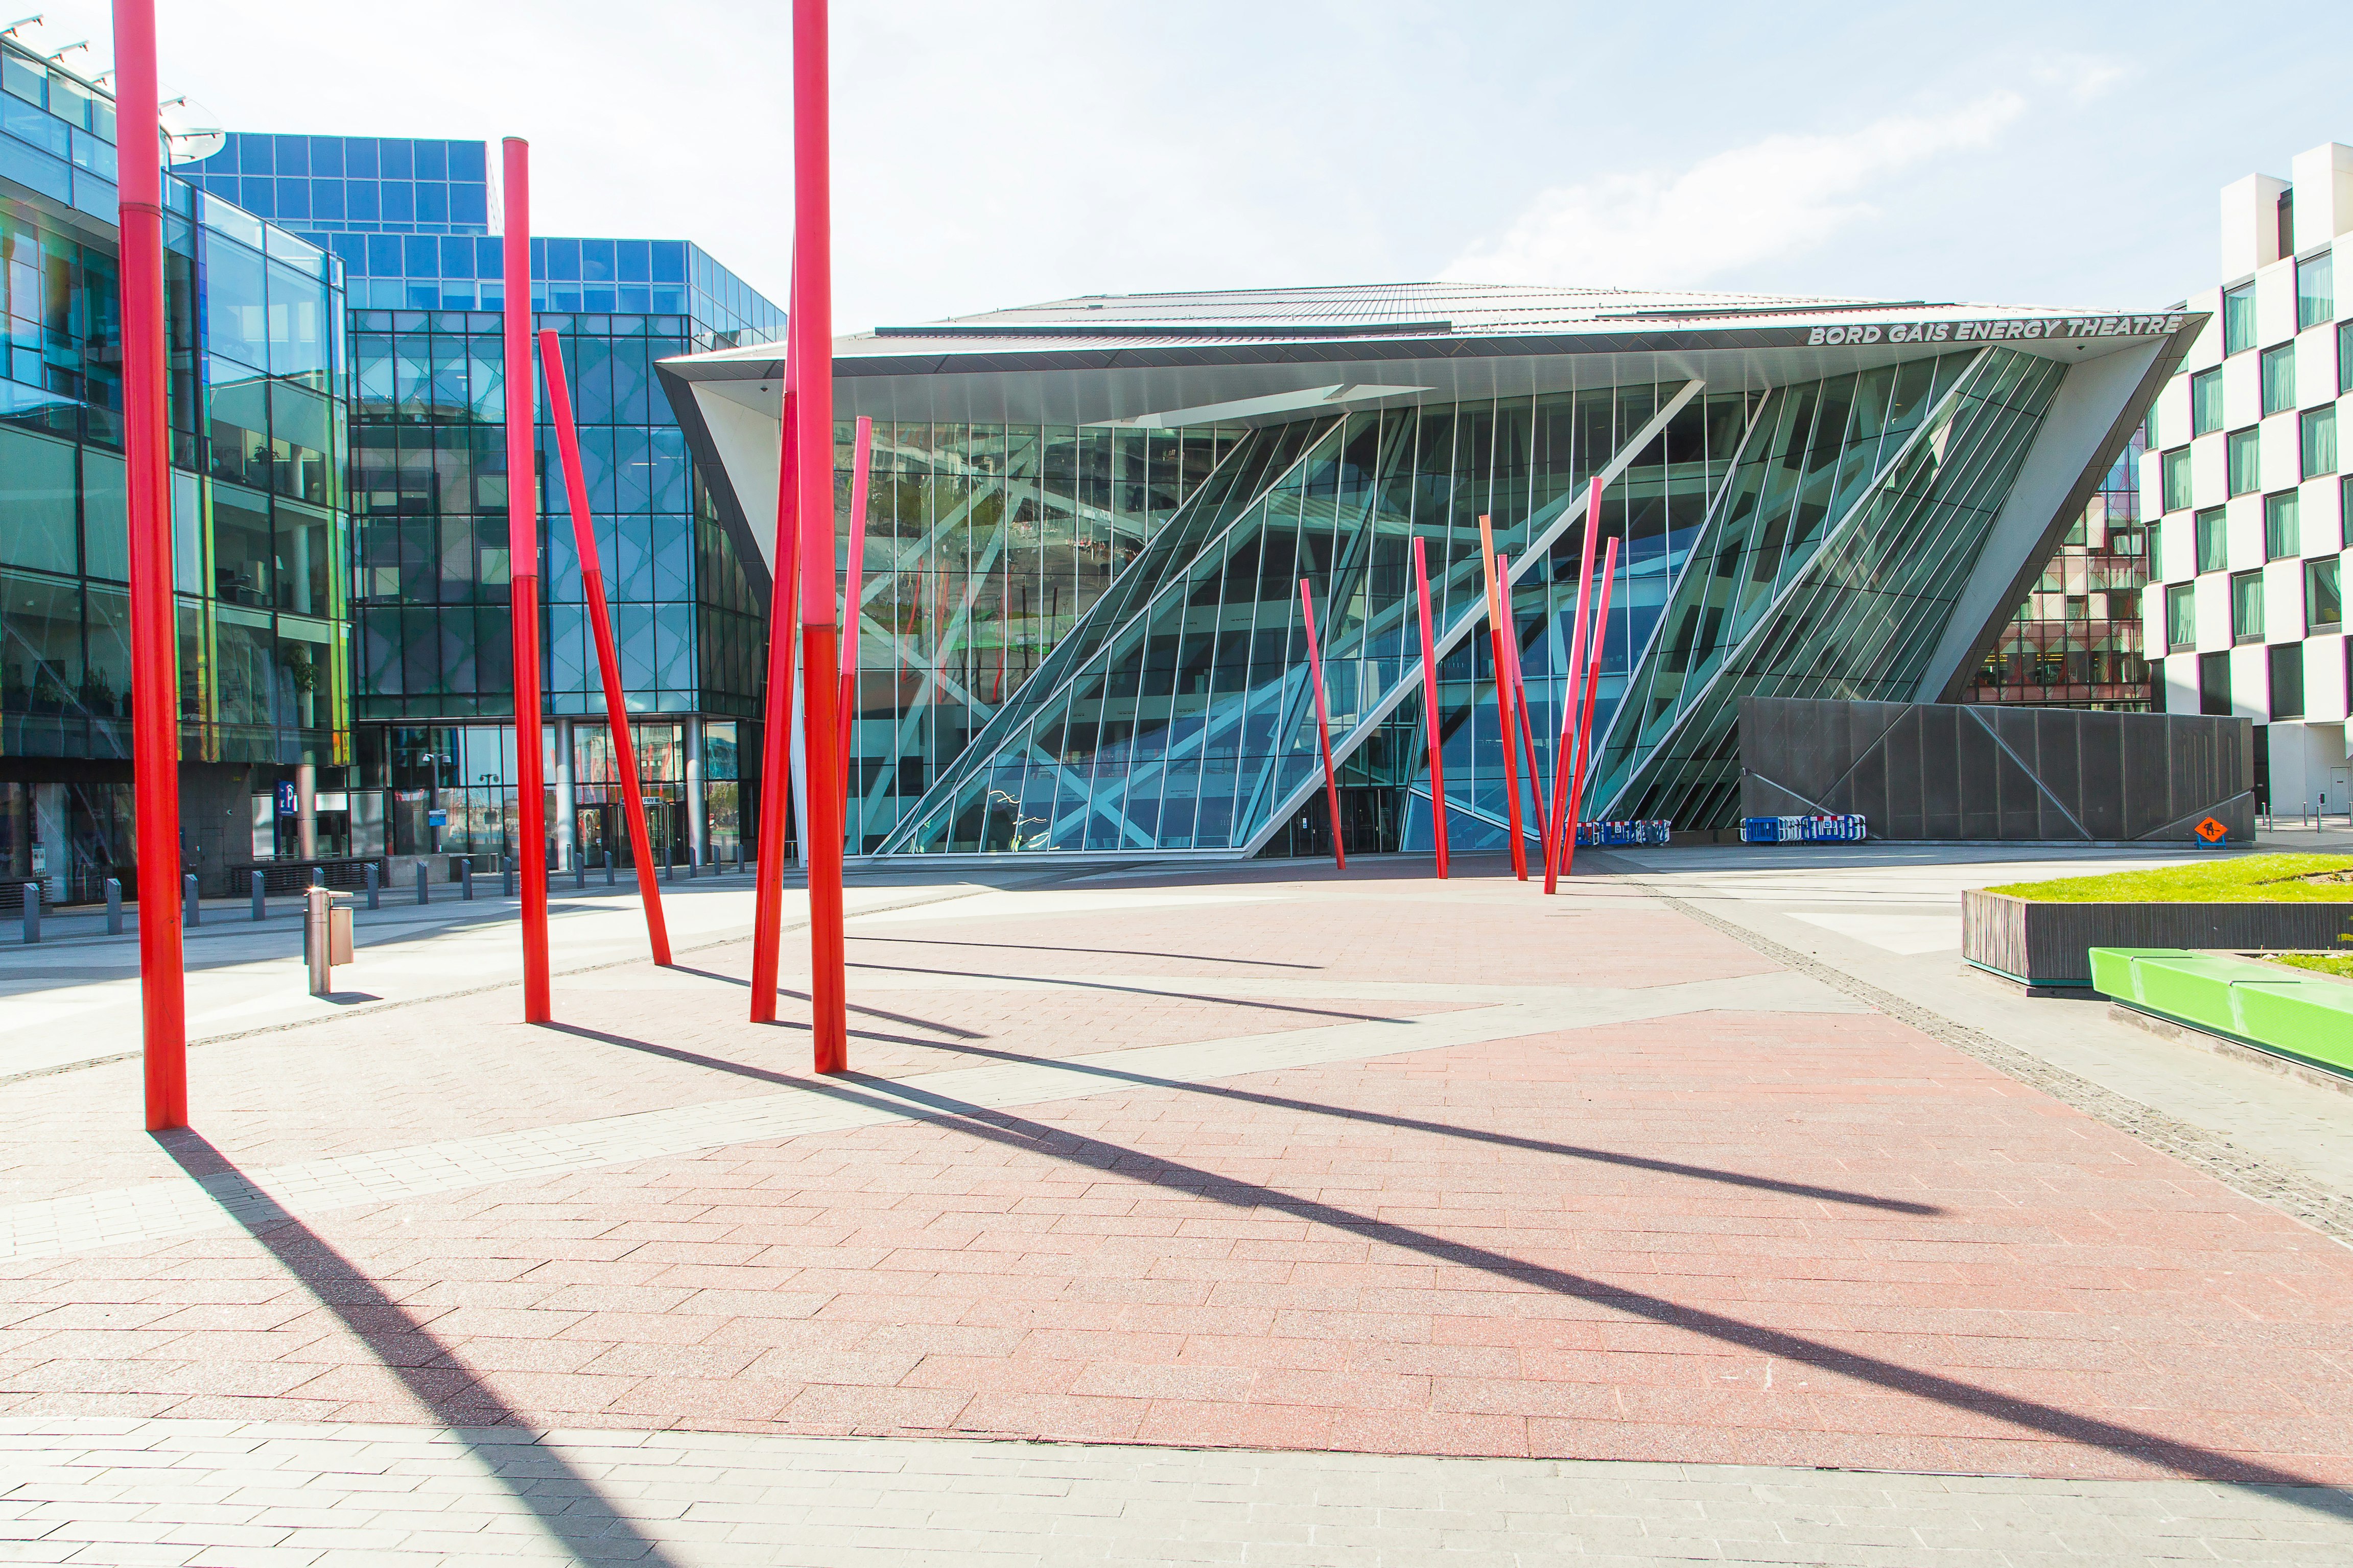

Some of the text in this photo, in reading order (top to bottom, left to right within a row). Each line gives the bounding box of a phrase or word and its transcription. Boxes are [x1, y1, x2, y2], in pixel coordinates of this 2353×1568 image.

[1807, 325, 1881, 345] BORD
[1954, 320, 2061, 340] ENERGY
[2067, 316, 2182, 337] THEATRE
